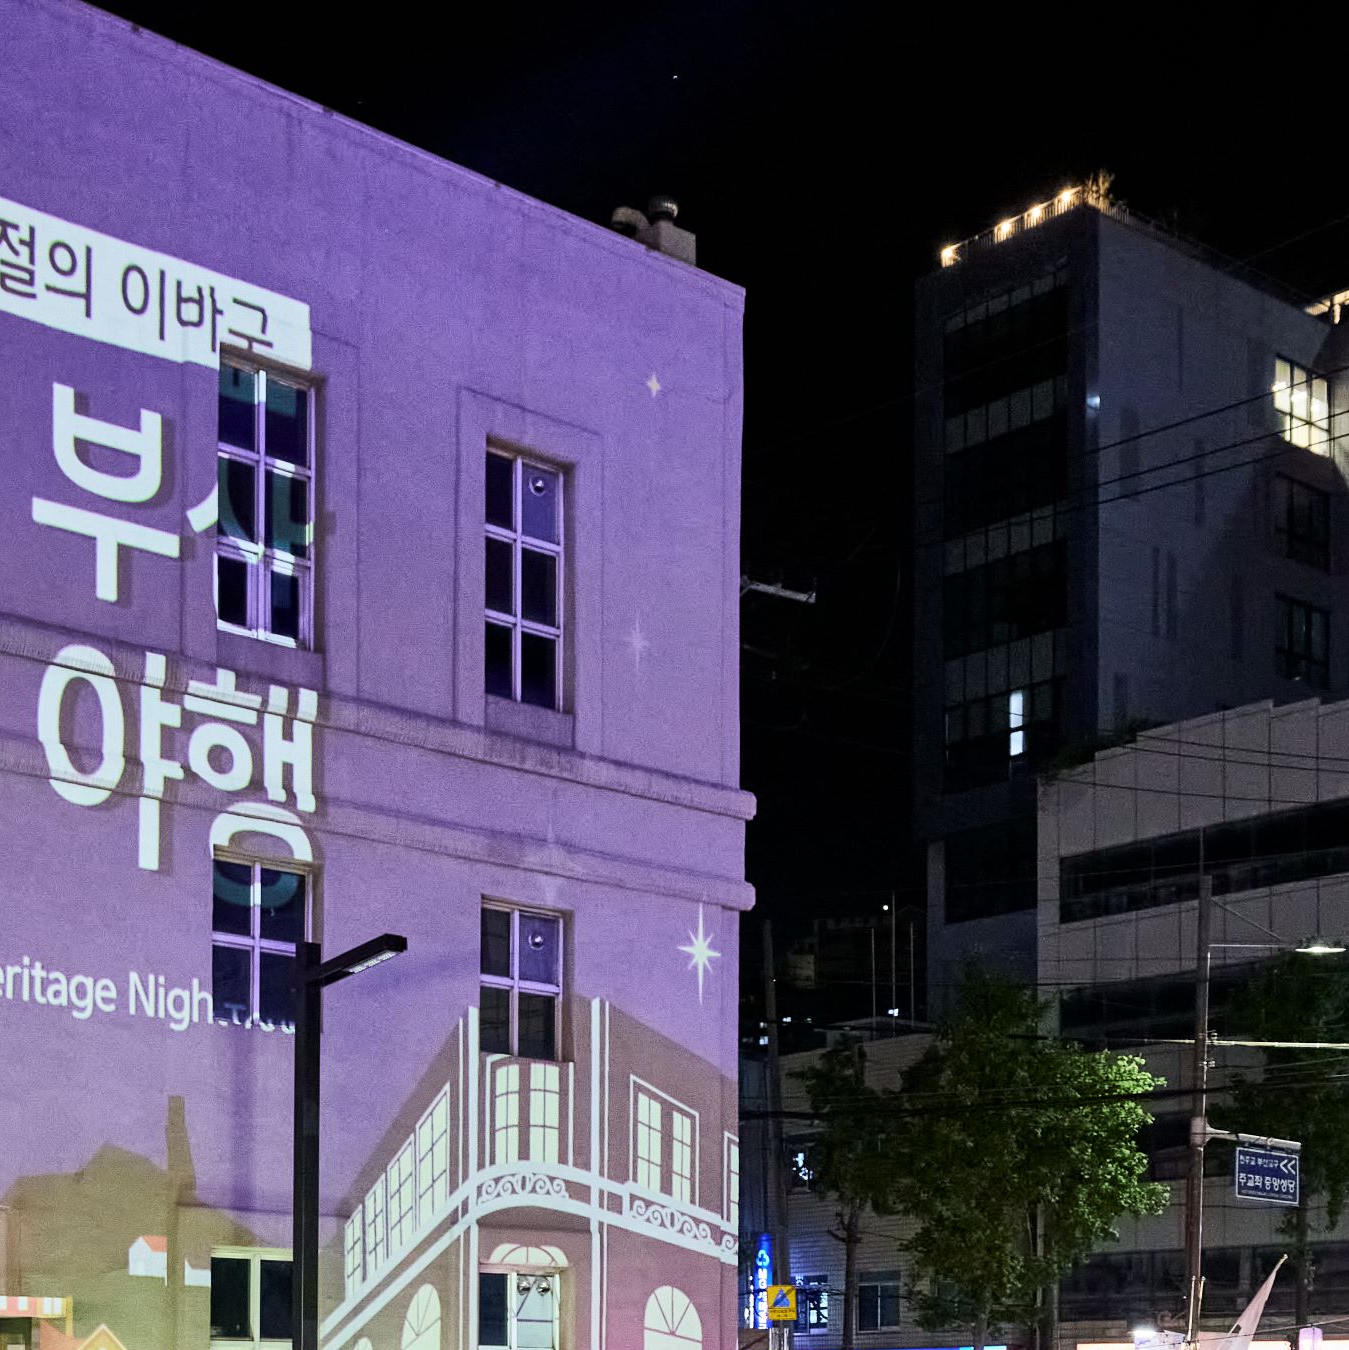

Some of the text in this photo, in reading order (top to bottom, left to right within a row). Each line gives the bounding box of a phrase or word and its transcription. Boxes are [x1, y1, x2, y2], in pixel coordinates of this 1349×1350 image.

[36, 643, 318, 908] 야행
[129, 968, 230, 1031] Nigh
[1264, 1176, 1295, 1192] 중앙성당
